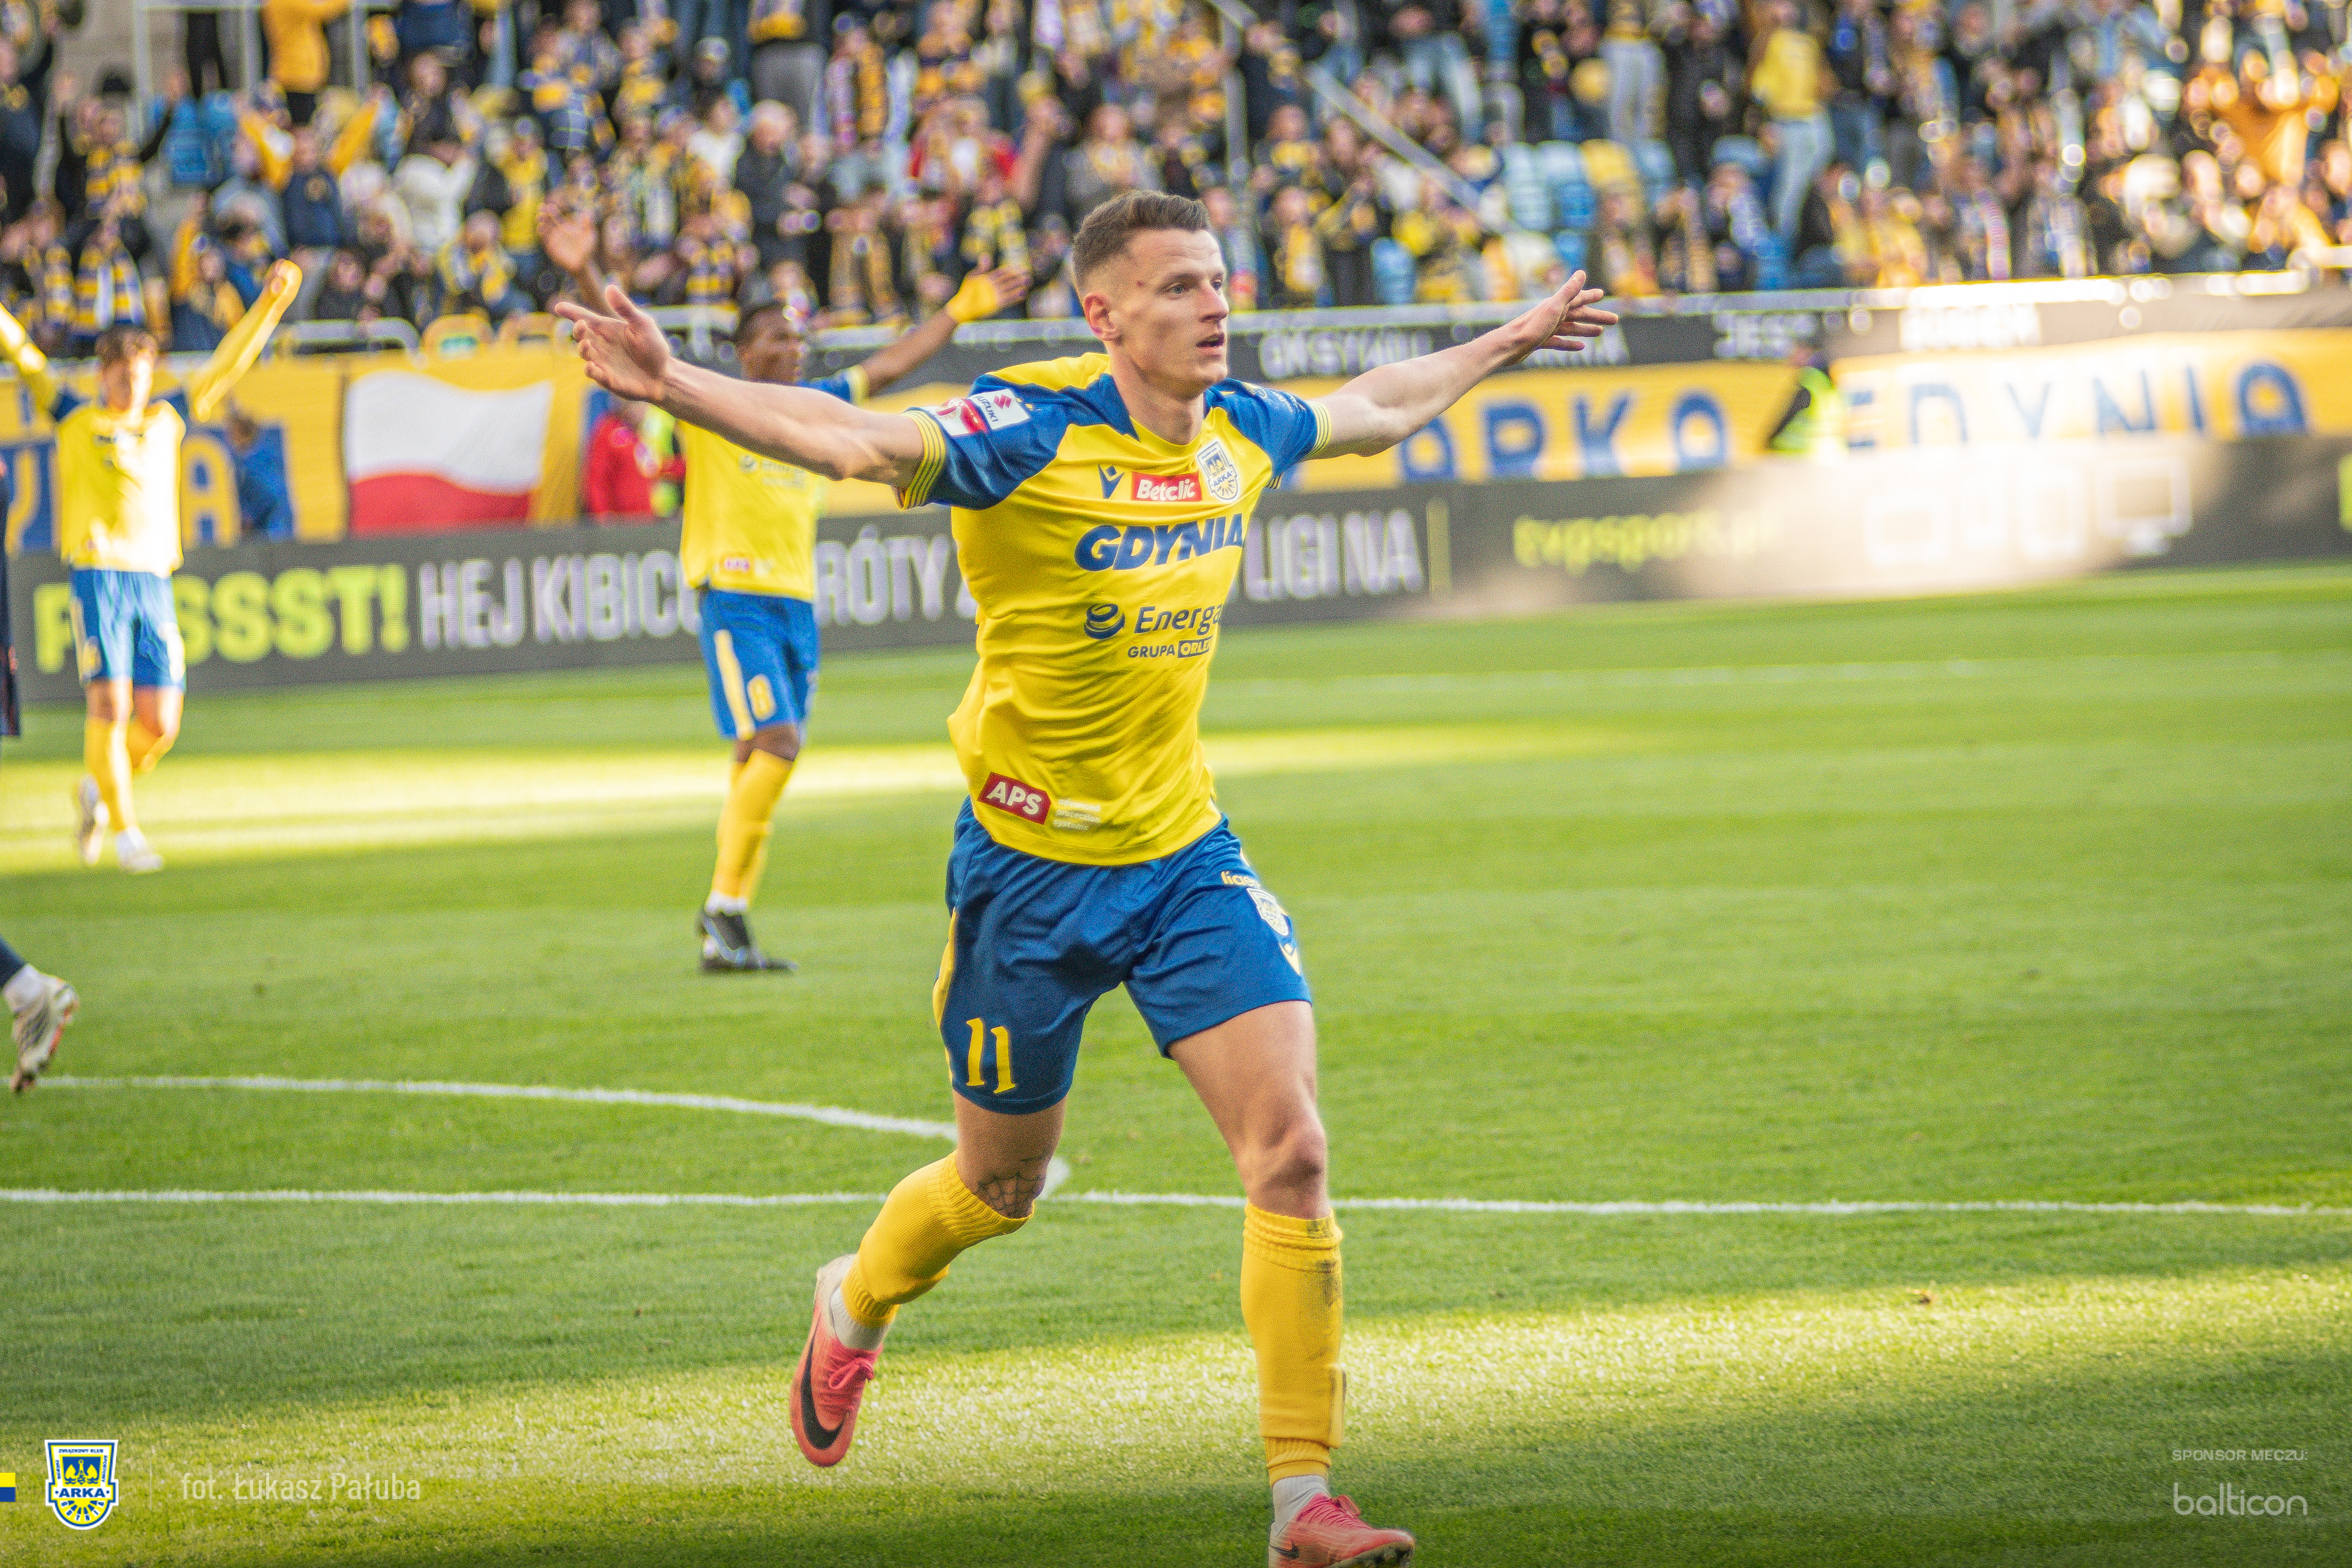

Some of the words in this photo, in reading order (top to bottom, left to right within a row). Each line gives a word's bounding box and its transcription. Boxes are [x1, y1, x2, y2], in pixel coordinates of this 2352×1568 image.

[1136, 478, 1195, 501] Betclic
[1213, 471, 1232, 487] ARKA
[1075, 513, 1245, 572] GDYNIA
[33, 563, 409, 674] PSSST!
[419, 558, 525, 649] HEJ
[815, 525, 950, 625] RÓTY
[1244, 514, 1339, 601] LIGI
[1342, 507, 1424, 595] NA
[1127, 644, 1176, 658] GRUPA
[1180, 640, 1211, 656] ORLE
[986, 781, 1042, 816] APS
[1058, 798, 1101, 812] advanced
[966, 1017, 1017, 1094] 11
